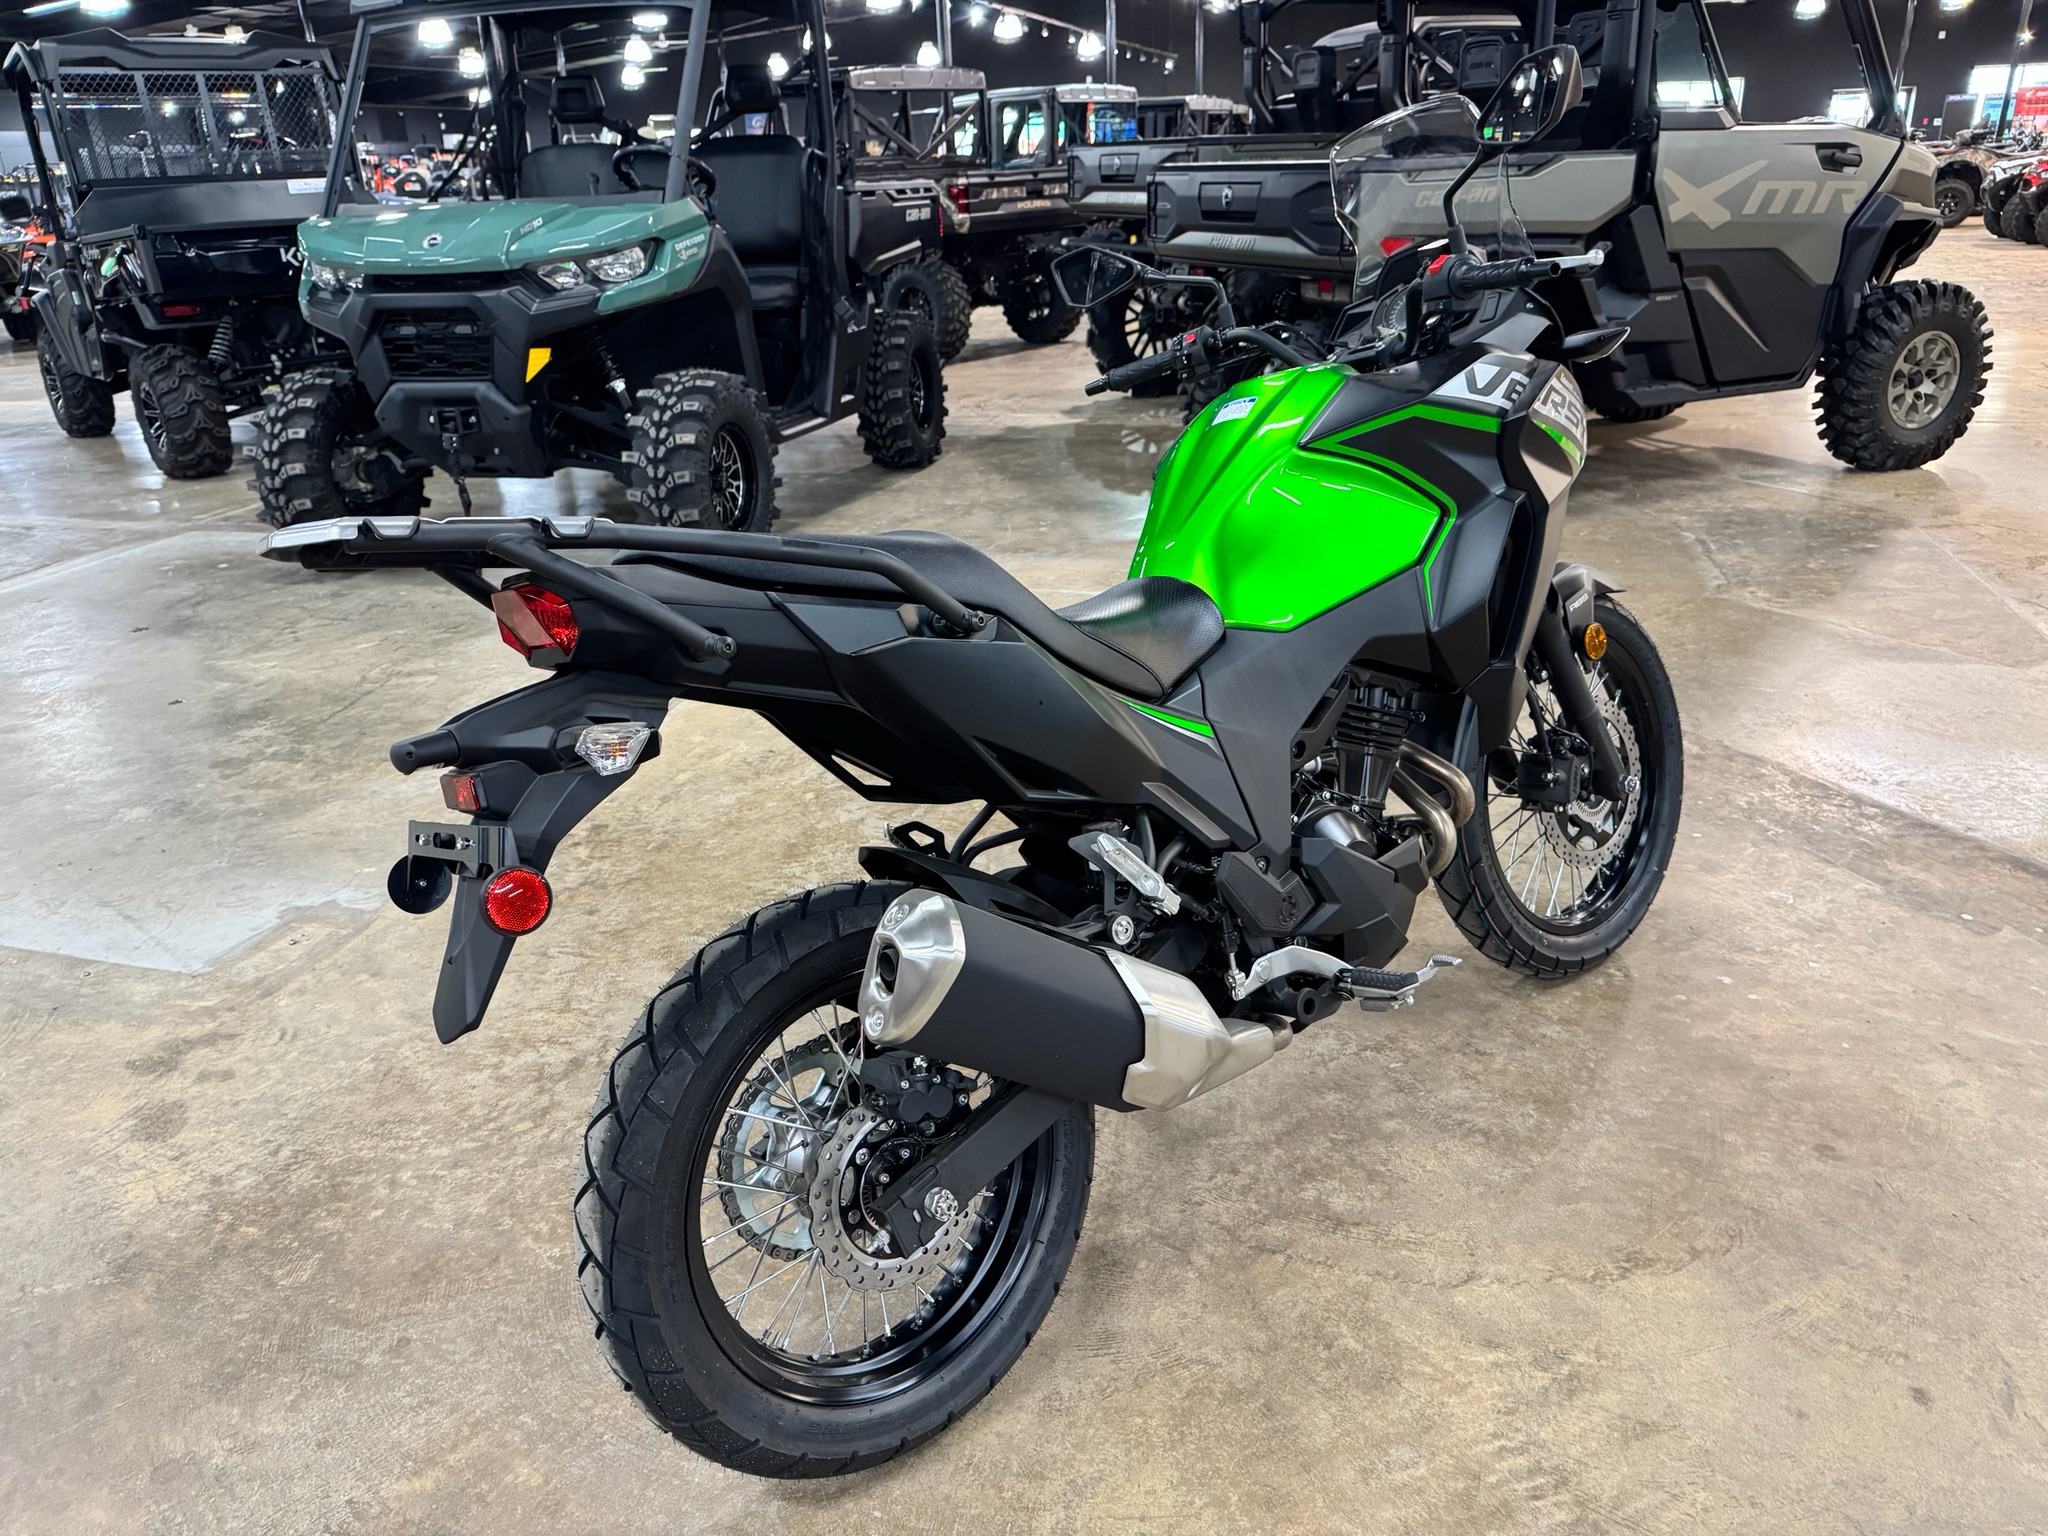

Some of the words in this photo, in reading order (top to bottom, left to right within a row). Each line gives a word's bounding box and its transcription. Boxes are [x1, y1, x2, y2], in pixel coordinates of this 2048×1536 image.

[905, 207, 932, 222] can-am
[1208, 234, 1257, 251] can-am
[1569, 592, 1589, 613] ABS
